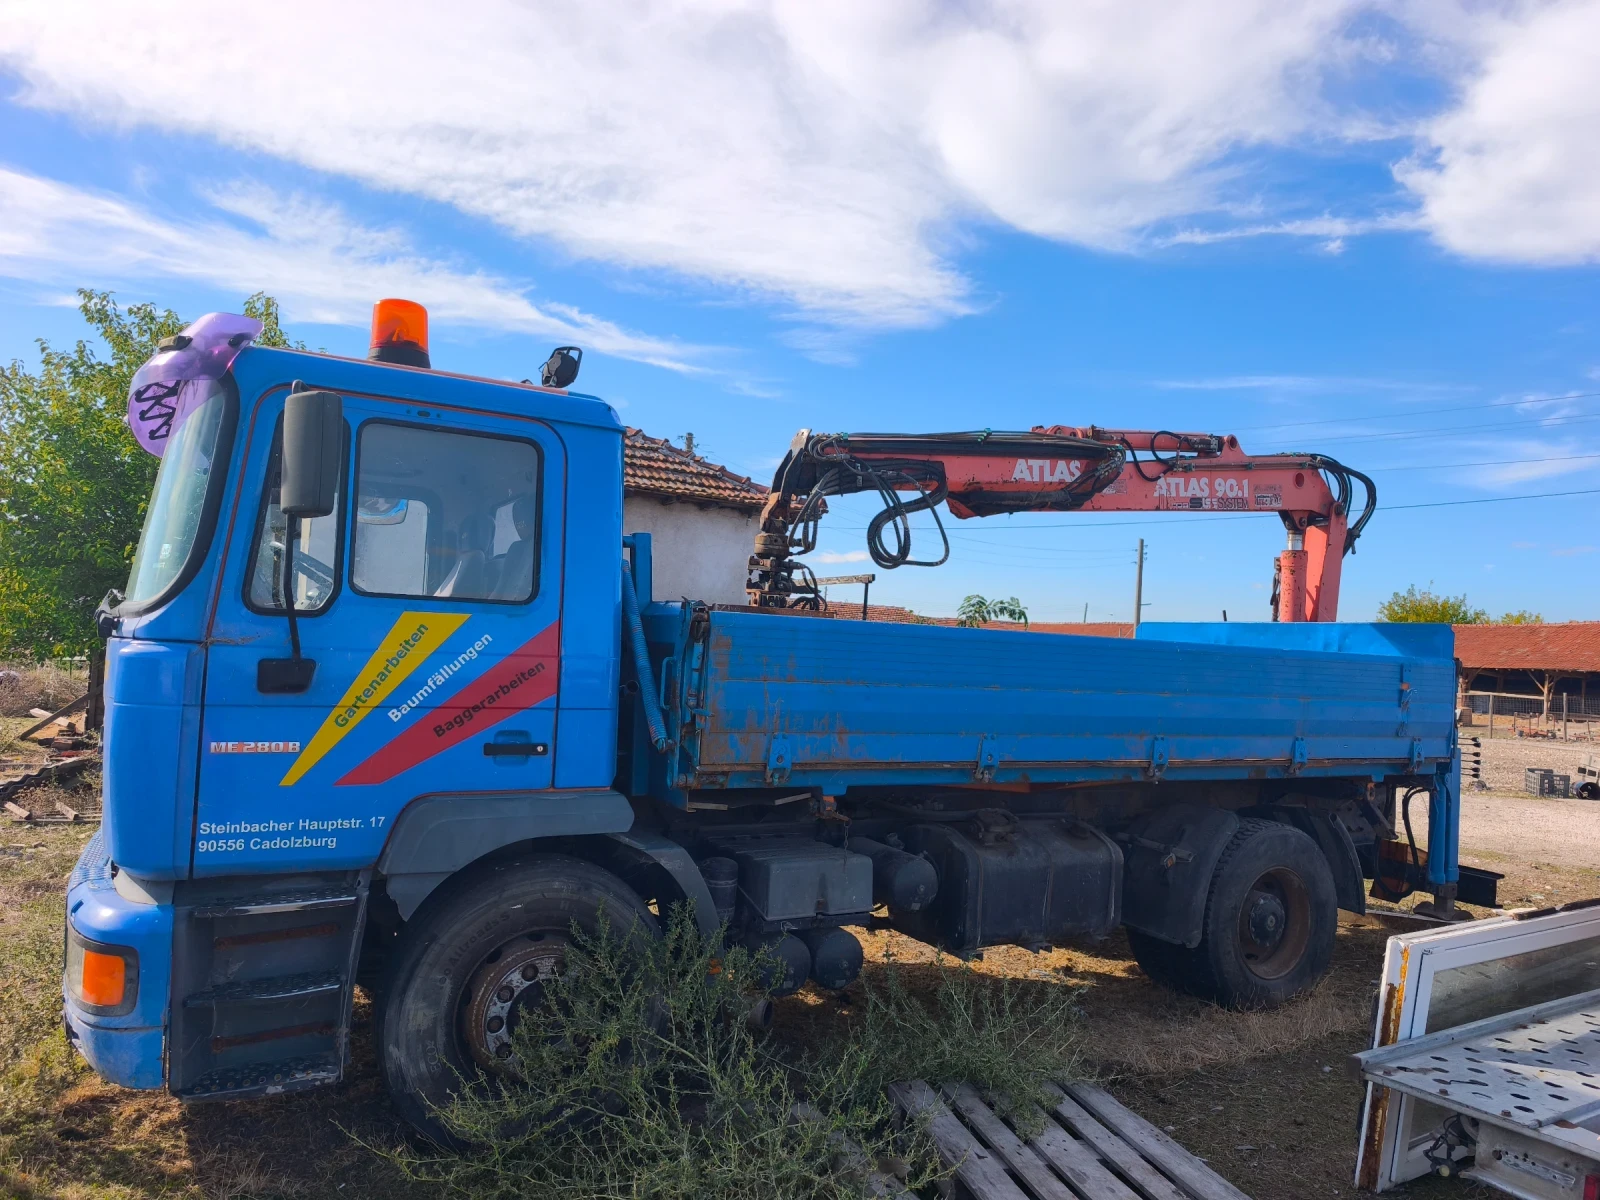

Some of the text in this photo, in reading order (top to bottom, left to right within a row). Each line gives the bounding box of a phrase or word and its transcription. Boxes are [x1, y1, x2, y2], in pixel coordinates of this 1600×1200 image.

[1011, 459, 1081, 482] ATLAS
[1153, 475, 1210, 497] ATLAS
[1214, 477, 1248, 497] 90.1
[334, 622, 429, 728] Gartenarbeiten
[387, 632, 493, 723] Baumfällungen
[433, 660, 546, 738] Baggerarbeiten
[210, 741, 300, 753] ME 280 B
[200, 816, 385, 835] Steinbacher Hauptstr. 17
[198, 836, 337, 853] 90556 Cadolzburg
